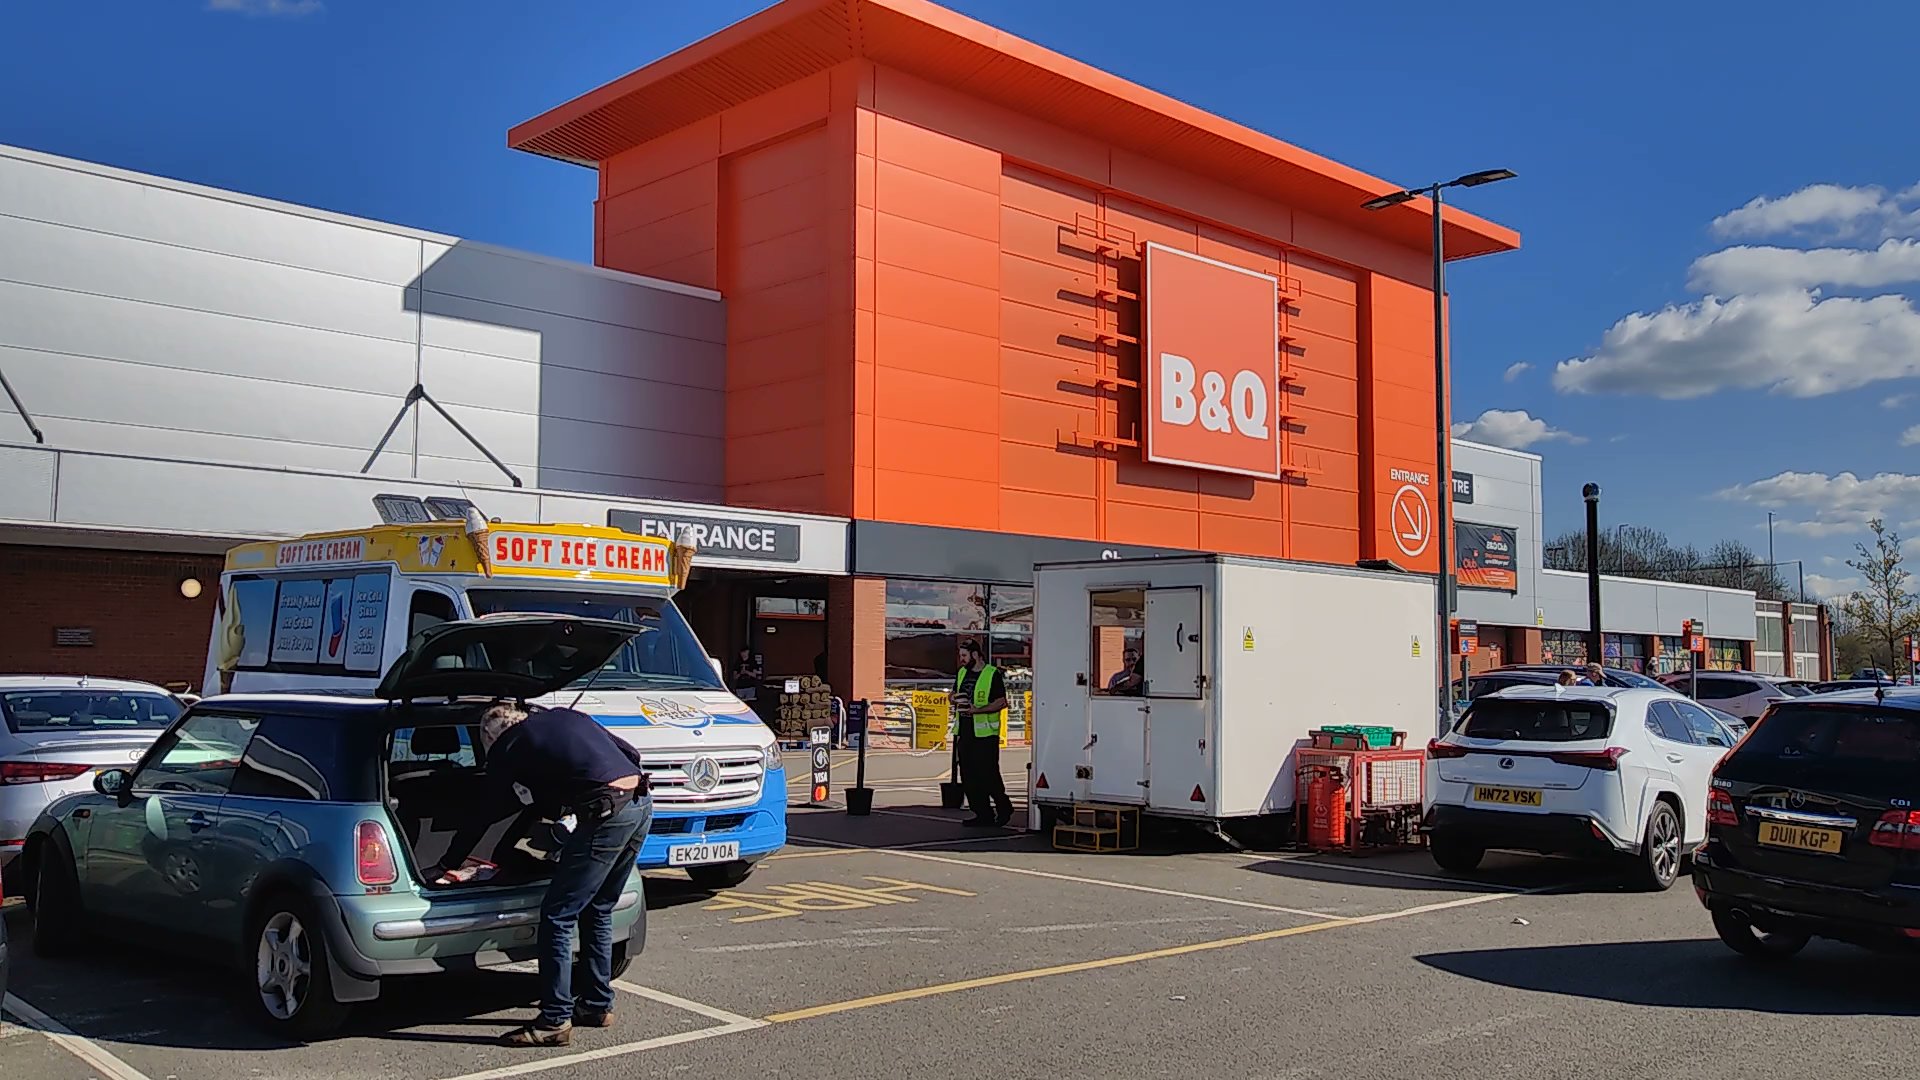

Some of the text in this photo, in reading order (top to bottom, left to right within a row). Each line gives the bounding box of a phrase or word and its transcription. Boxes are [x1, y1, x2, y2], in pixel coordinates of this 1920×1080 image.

[1160, 352, 1269, 440] B&Q
[1390, 468, 1430, 486] ENTRANCE
[641, 518, 776, 552] ENTRANCE
[279, 540, 362, 564] SOFT ICE CREAM
[496, 536, 666, 573] SOFT ICE CREAM
[914, 694, 947, 706] 20% off
[813, 771, 829, 784] VISA
[1478, 787, 1538, 804] HN72 VSK
[1890, 798, 1911, 807] CDI
[1769, 825, 1830, 849] DU11 KGP
[675, 843, 734, 862] EK20 VOA
